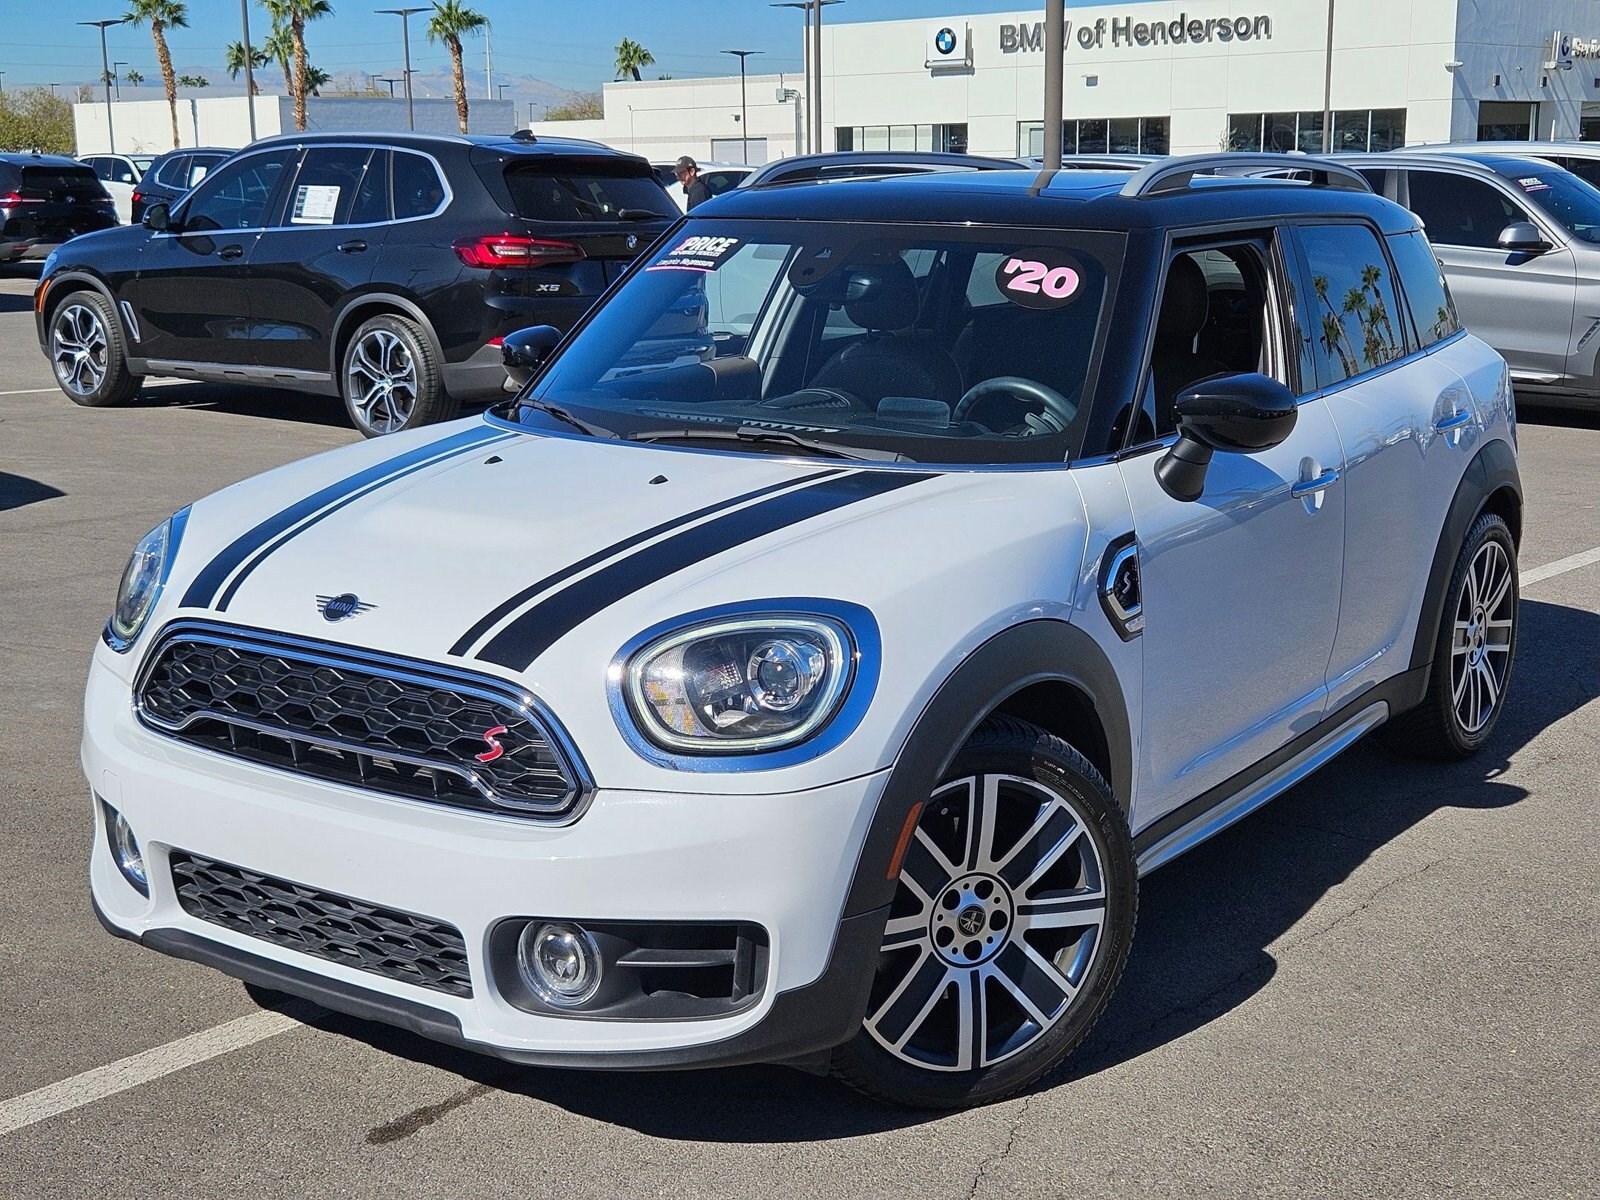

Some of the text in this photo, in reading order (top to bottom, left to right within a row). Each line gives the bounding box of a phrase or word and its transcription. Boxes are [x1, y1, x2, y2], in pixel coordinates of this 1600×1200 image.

[1077, 17, 1107, 50] of
[1111, 12, 1272, 47] Henderson
[535, 284, 561, 292] X5
[1003, 258, 1080, 299] '20
[327, 601, 353, 613] MINI
[474, 725, 509, 763] S
